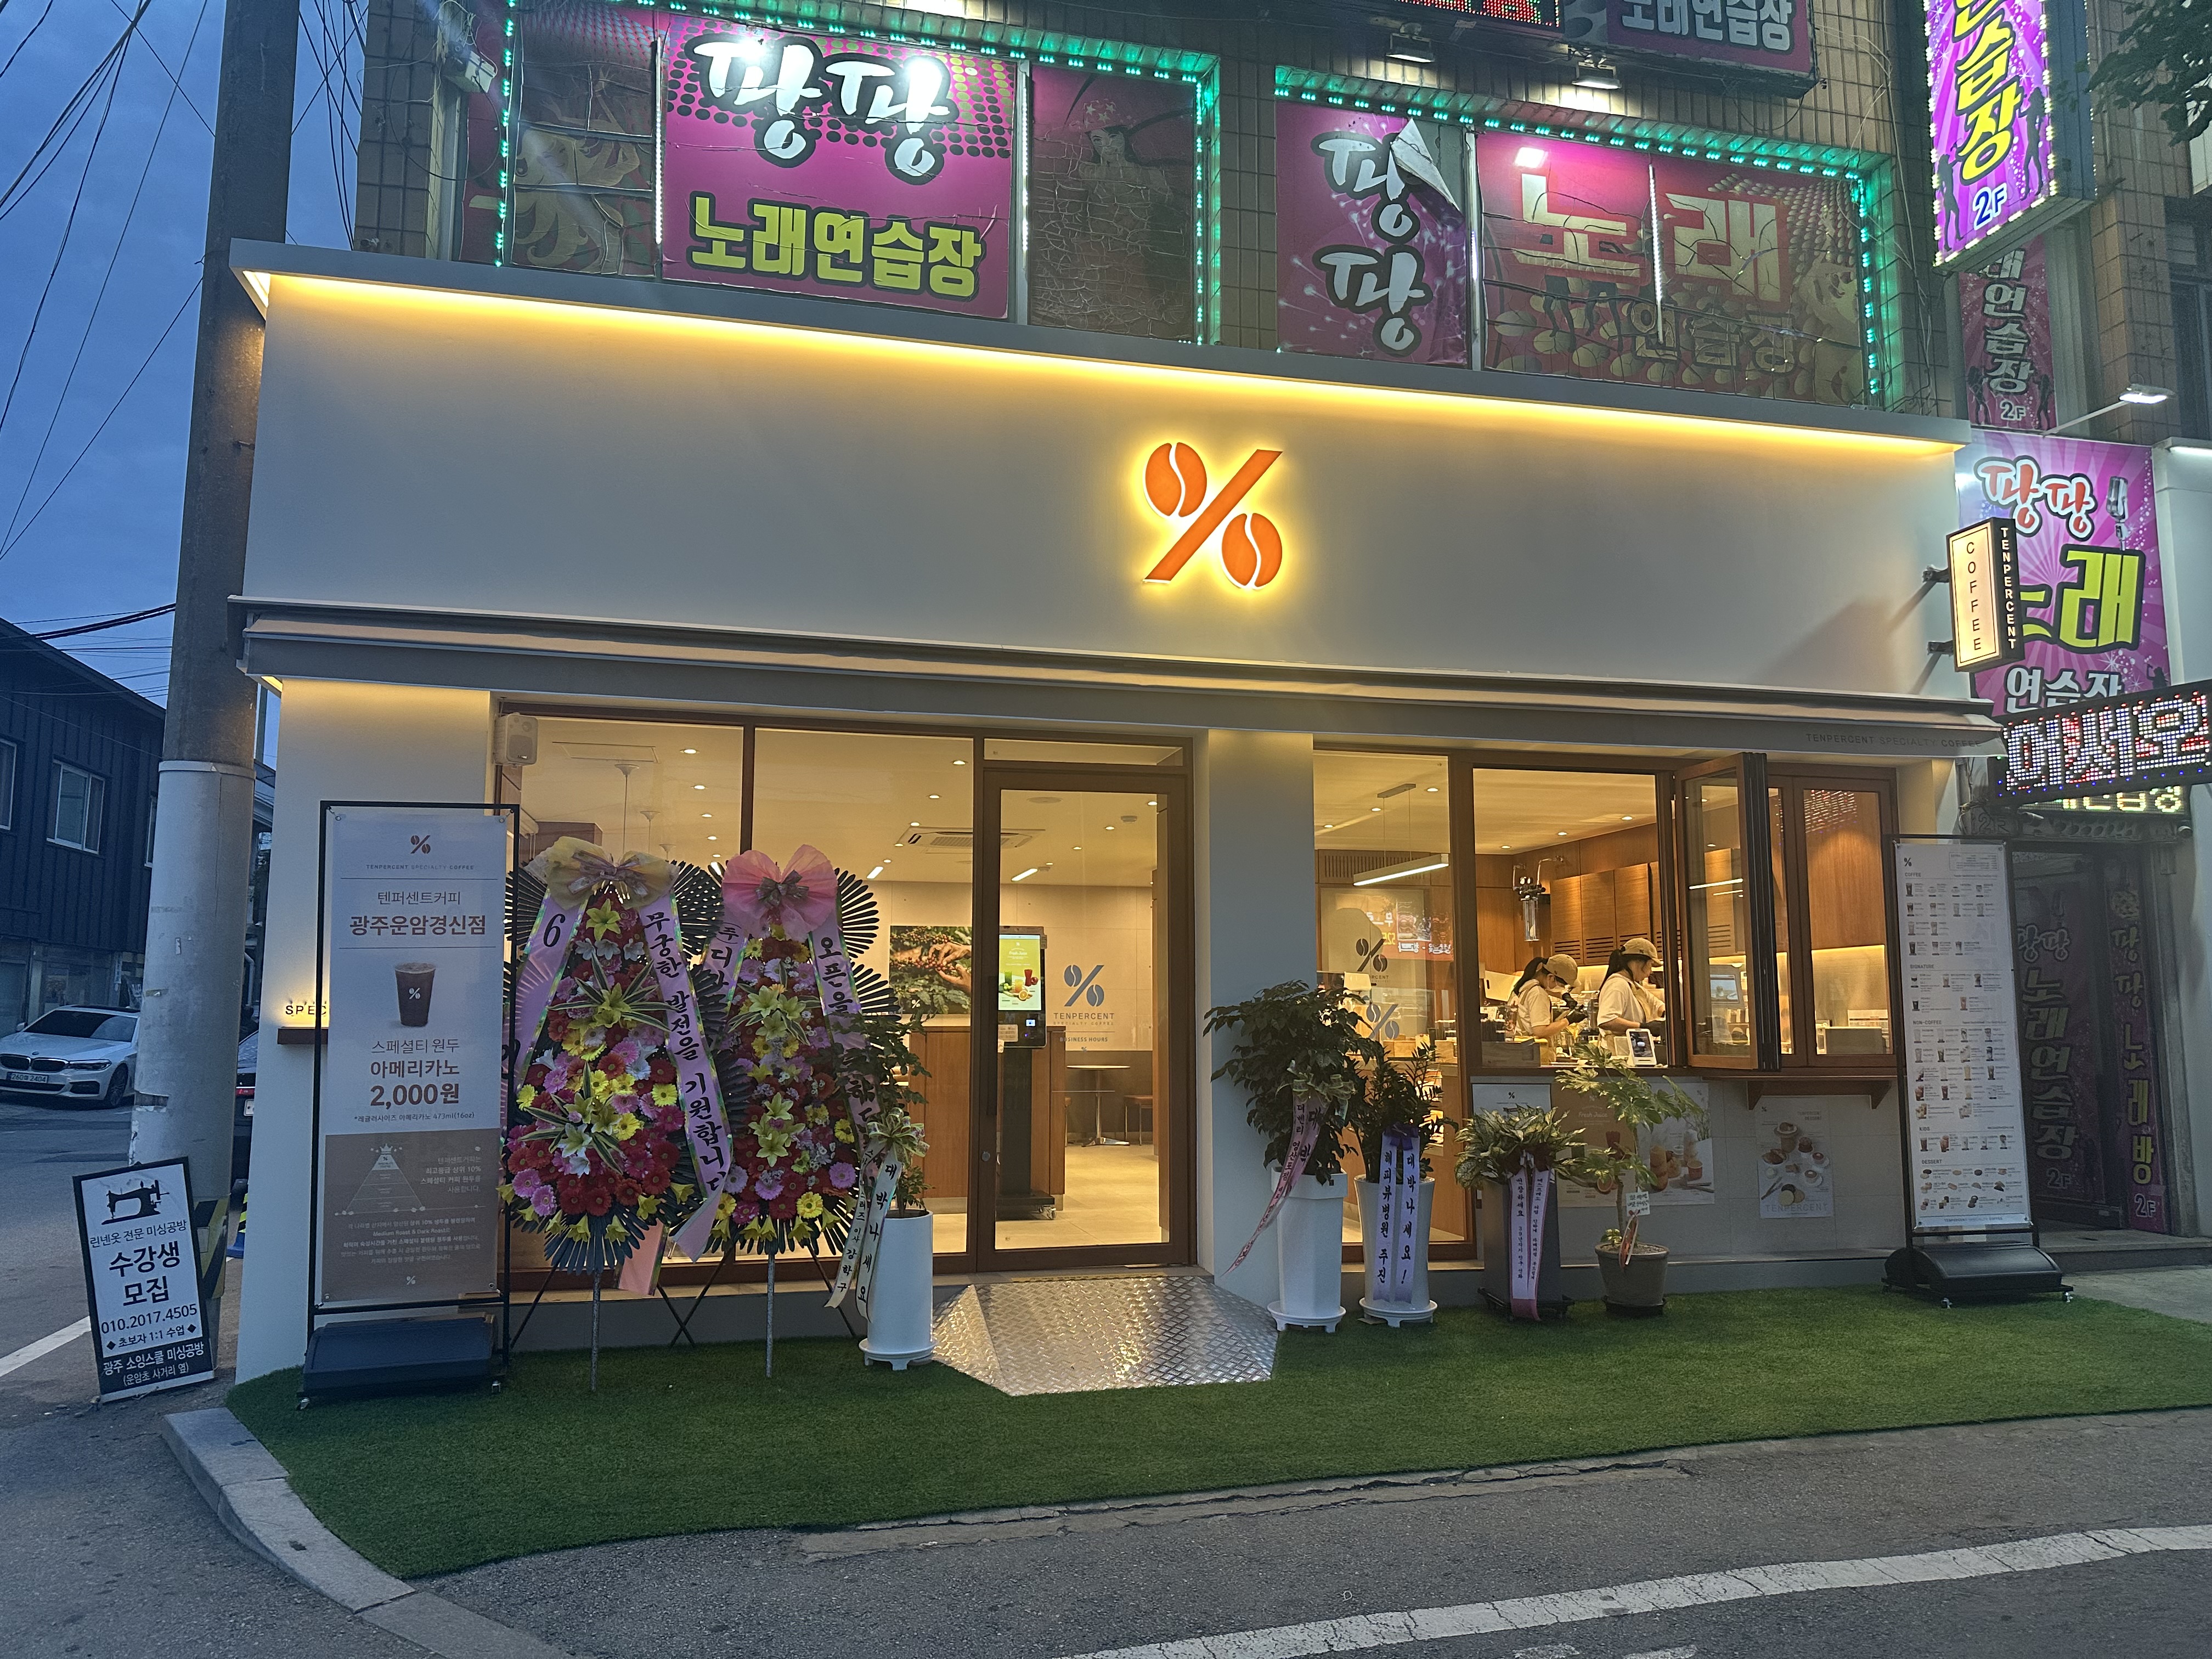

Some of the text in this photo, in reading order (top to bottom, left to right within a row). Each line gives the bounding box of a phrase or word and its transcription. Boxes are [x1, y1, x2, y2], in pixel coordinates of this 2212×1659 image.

[1974, 187, 2007, 228] 2F
[692, 196, 982, 297] 노래연습장
[1513, 173, 1781, 302] 노래
[2001, 402, 2026, 420] 2F
[1966, 541, 1983, 652] COFFEE
[2000, 528, 2017, 650] TENPERCENT
[1806, 733, 1982, 747] TENPERCENT SPECIALTY COFFEE
[377, 891, 461, 906] 텐퍼센트커피
[349, 915, 487, 936] 광주운암경신점
[645, 911, 682, 978] 무궁한
[664, 990, 699, 1061] 발전을
[817, 936, 854, 1014] 오픈을
[371, 1038, 460, 1054] 스페셜티 원두
[370, 1059, 460, 1077] 아메리카노
[2022, 967, 2079, 1160] 노래연습장
[370, 1082, 460, 1109] 2,000원
[2047, 1169, 2072, 1188] 2F
[1401, 1153, 1417, 1284] 대박나세요!
[2135, 1194, 2156, 1217] 2F
[123, 1231, 144, 1240] 전문
[146, 1219, 187, 1238] 미싱공방
[857, 1163, 898, 1303] 대박나세요
[109, 1240, 180, 1277] 수강생
[123, 1276, 169, 1306] 모집
[100, 1304, 198, 1334] 010.2017.4505
[118, 1324, 185, 1348] 초보자 1:1 수업
[103, 1342, 204, 1376] 광주 소잉스쿨 미싱공방
[123, 1362, 189, 1387] (운암초 사거리 옆)
